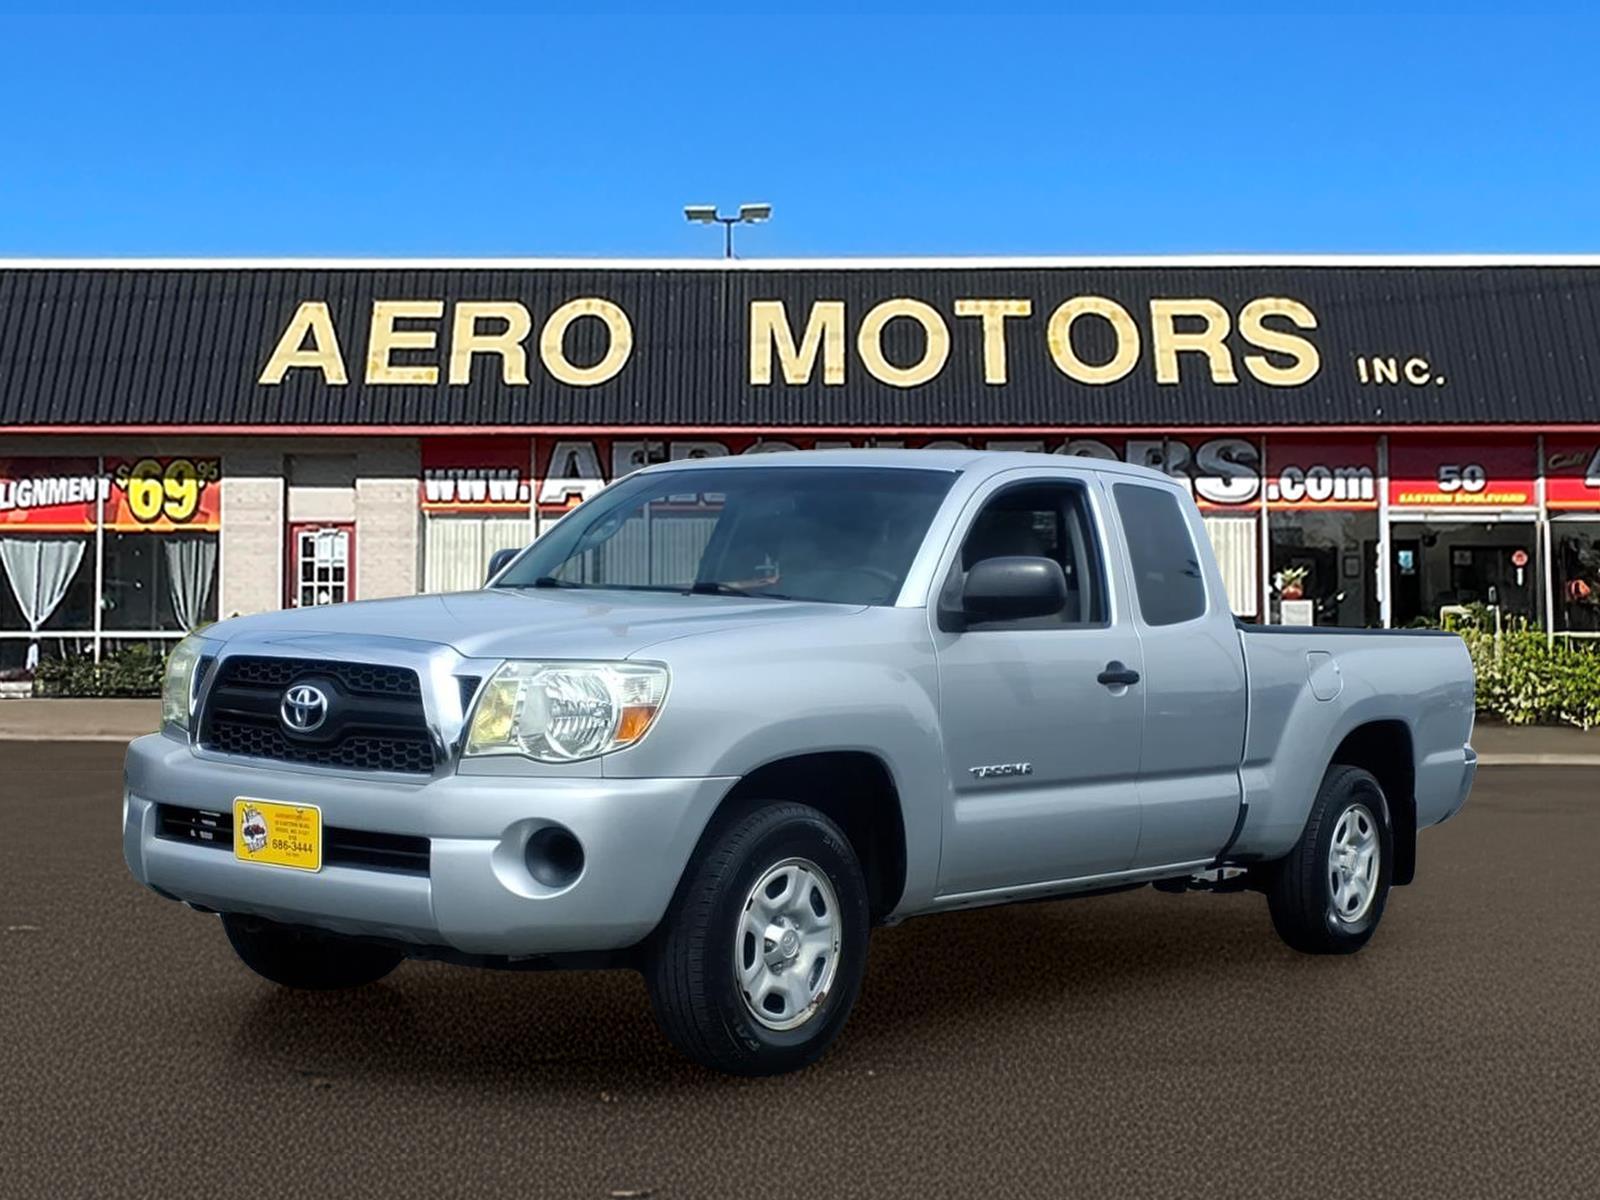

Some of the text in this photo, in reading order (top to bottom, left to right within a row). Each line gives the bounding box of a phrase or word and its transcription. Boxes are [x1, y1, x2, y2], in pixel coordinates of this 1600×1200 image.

[258, 296, 1446, 389] AERO MOTORS INC.
[1437, 464, 1486, 492] 50
[1399, 492, 1527, 504] EASTERN BOULEVARD
[272, 839, 312, 853] 686-3444
